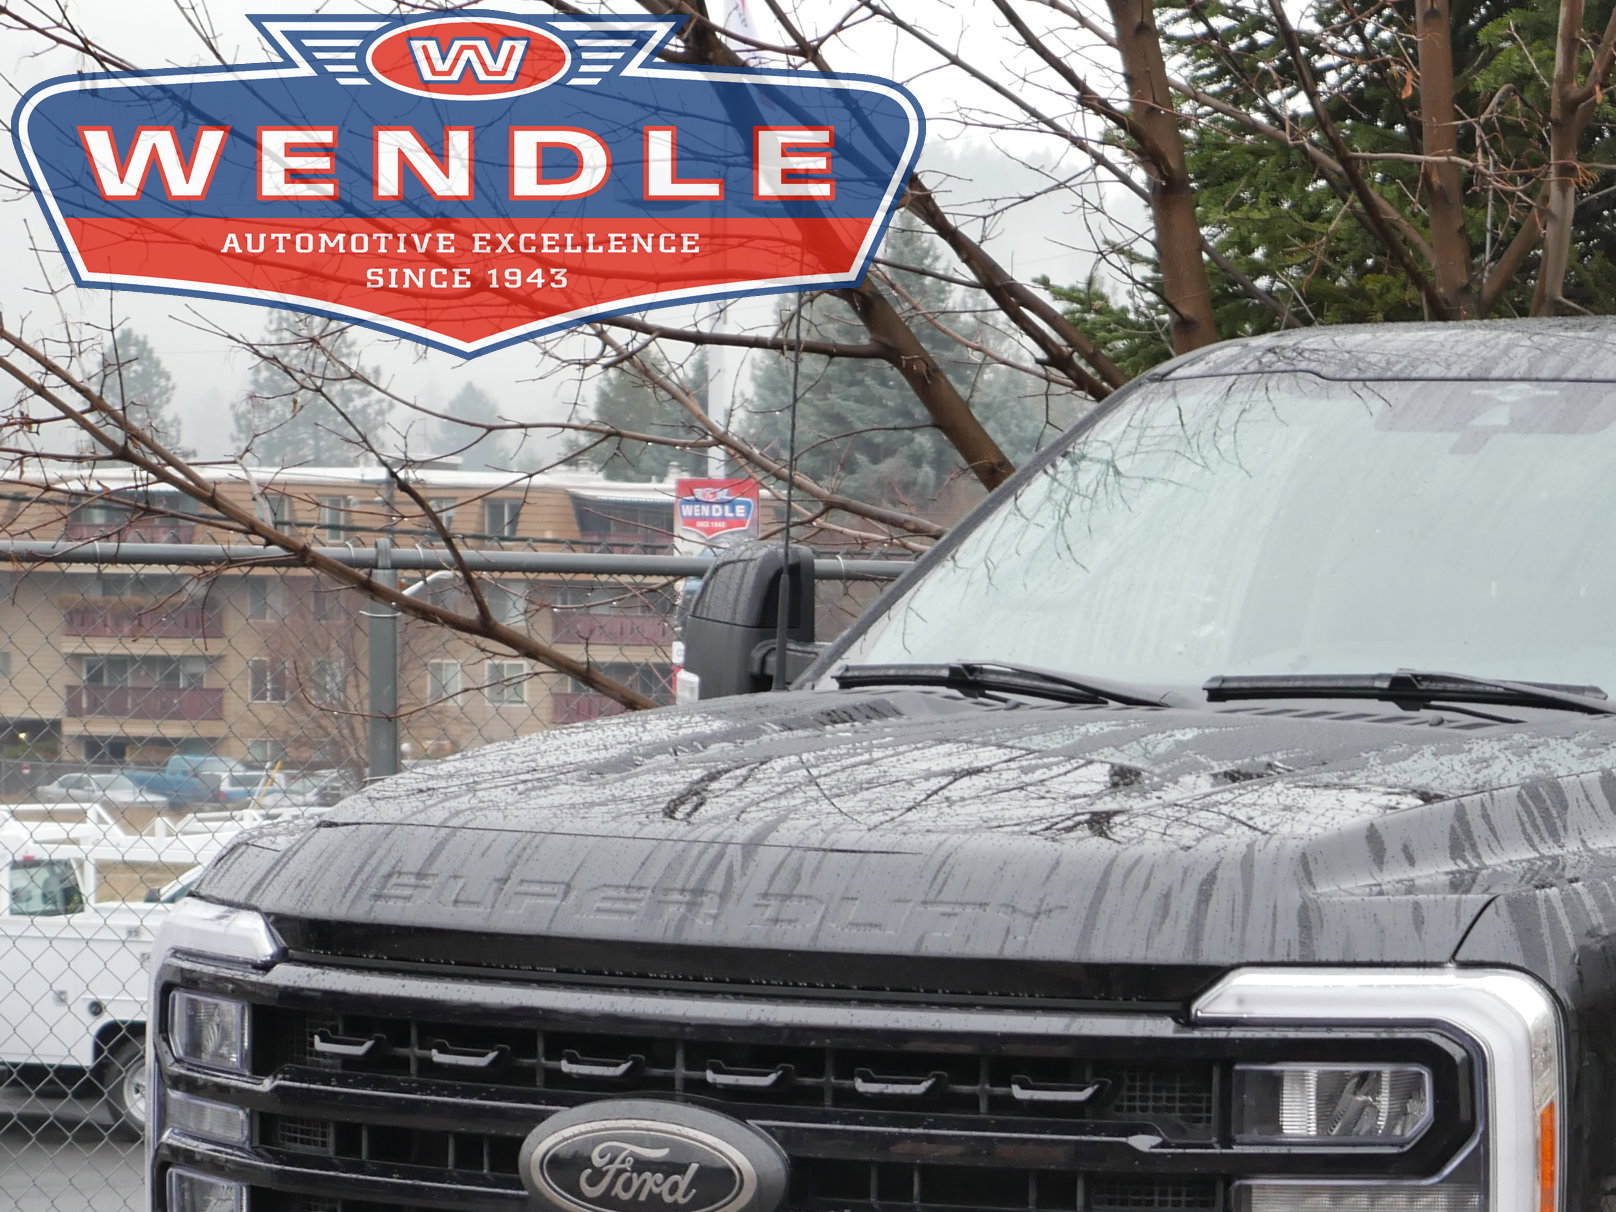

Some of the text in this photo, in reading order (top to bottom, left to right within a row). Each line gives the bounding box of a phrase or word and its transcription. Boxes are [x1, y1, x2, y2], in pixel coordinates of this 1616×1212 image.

[681, 504, 746, 517] WENDLE
[367, 871, 1070, 940] SUPER DUTY
[579, 1141, 700, 1204] Ford
